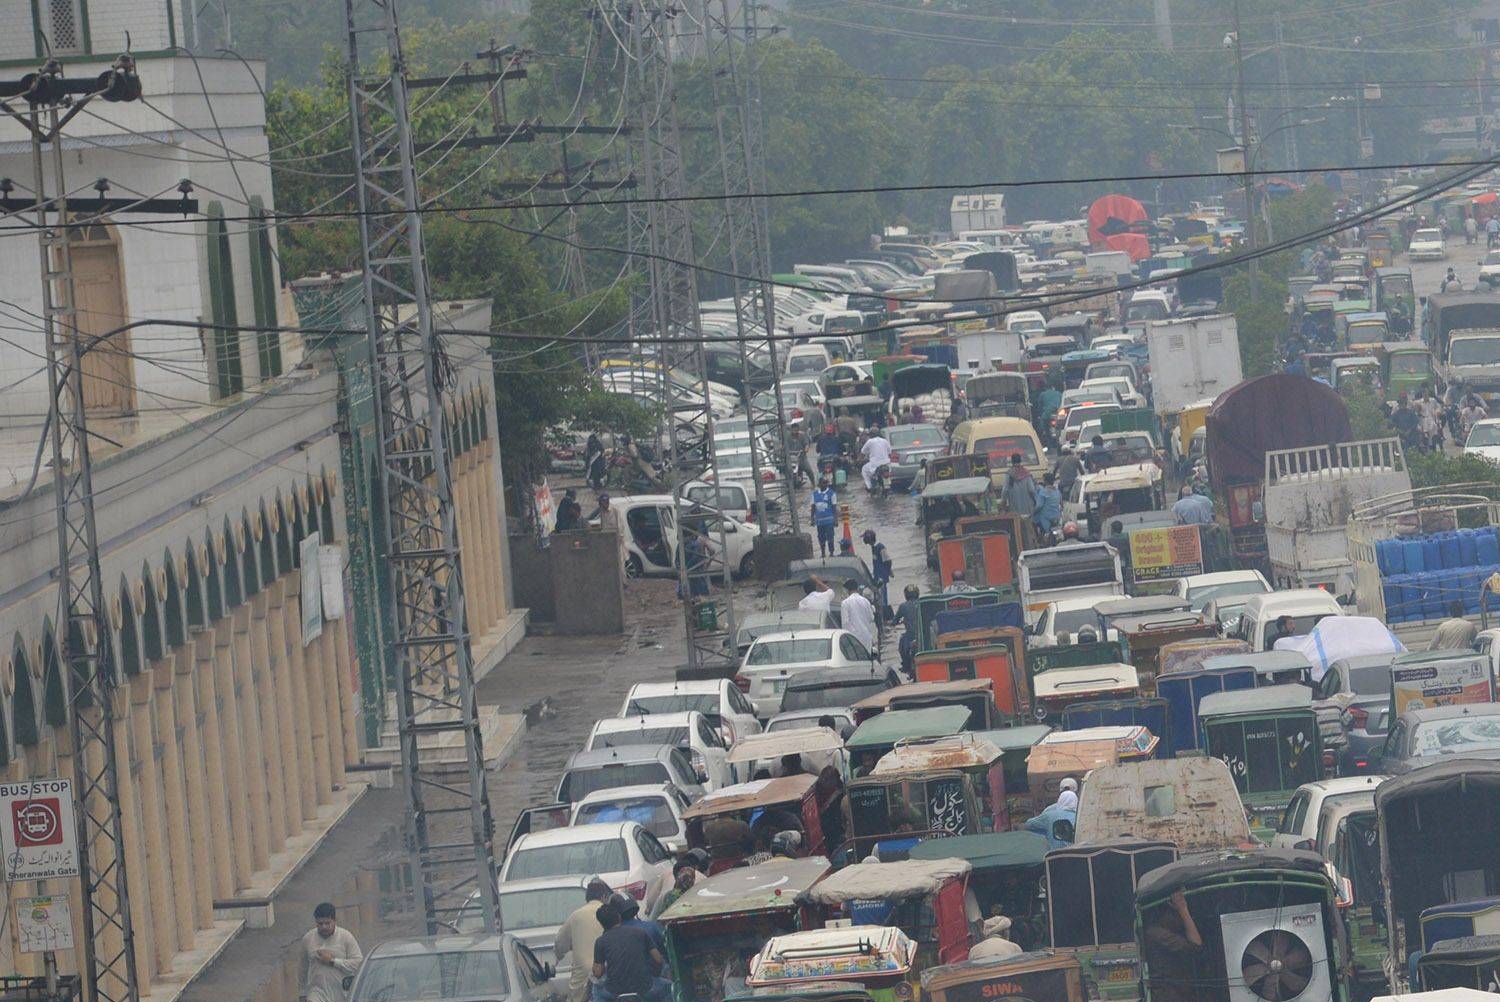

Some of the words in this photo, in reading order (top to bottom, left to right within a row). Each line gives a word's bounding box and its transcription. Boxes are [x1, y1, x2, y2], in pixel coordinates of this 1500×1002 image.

[1, 785, 29, 796] BUS
[33, 782, 68, 794] STOP
[57, 867, 77, 875] Gate
[982, 983, 1023, 997] SIWA
